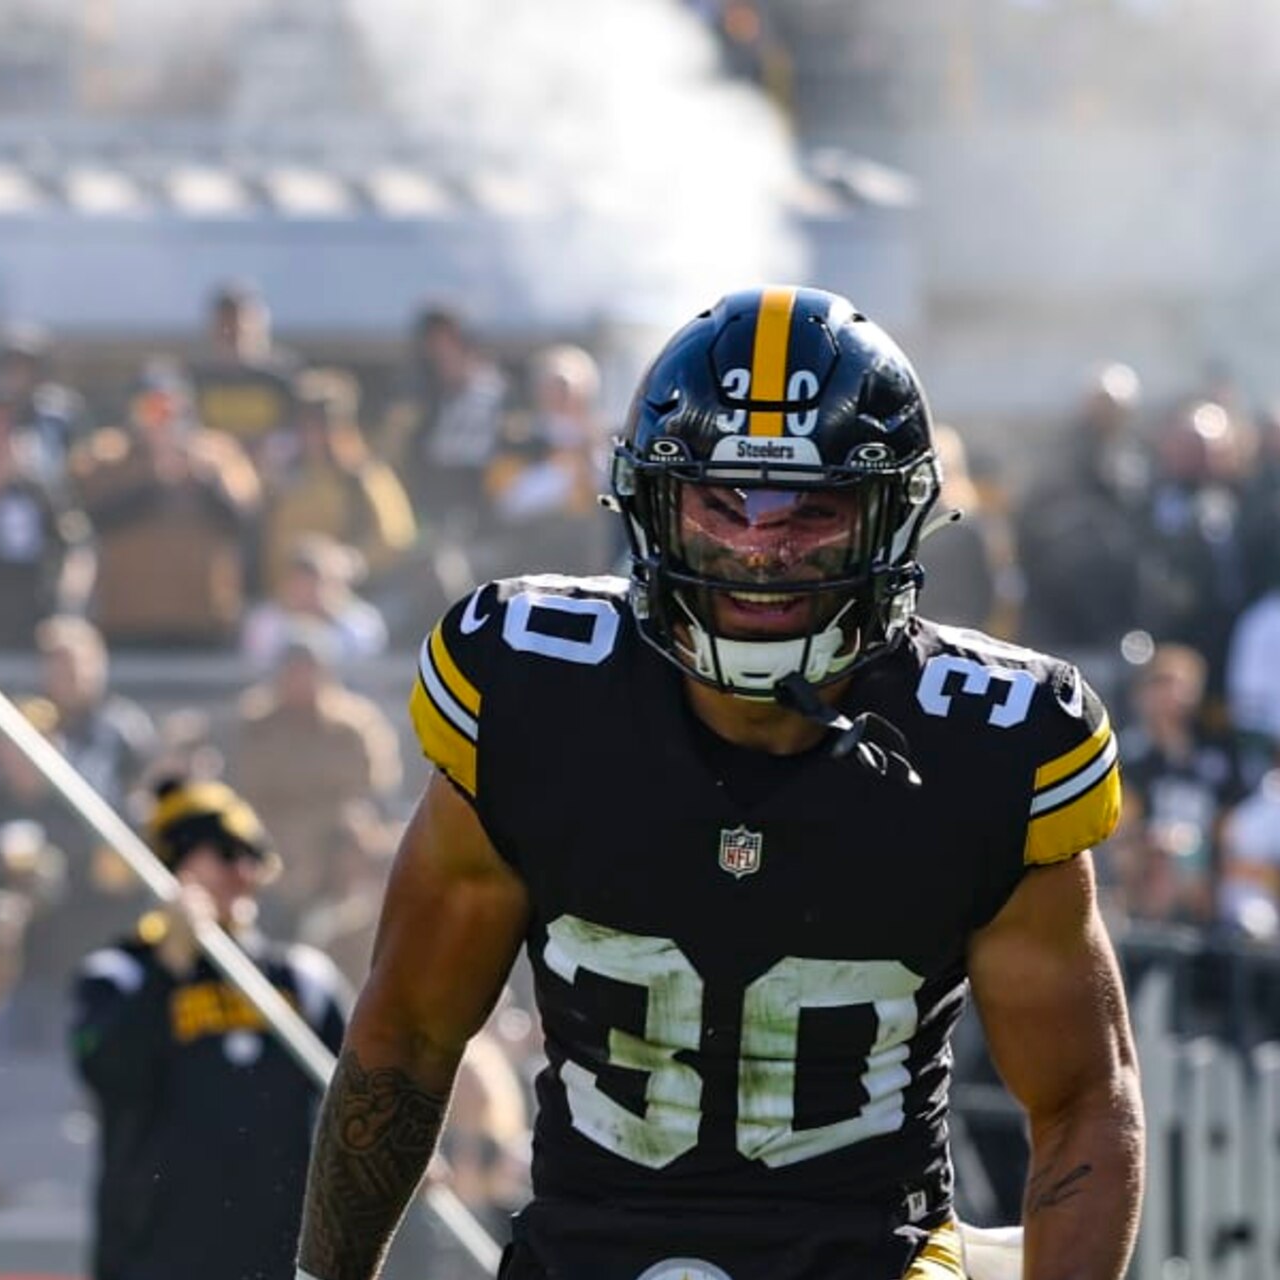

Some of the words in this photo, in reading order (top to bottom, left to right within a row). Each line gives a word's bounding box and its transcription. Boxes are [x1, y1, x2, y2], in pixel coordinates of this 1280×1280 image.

[717, 368, 819, 437] 30
[736, 440, 795, 459] Steelers
[502, 590, 620, 665] 0
[916, 653, 1040, 729] 3
[725, 847, 756, 869] NFL
[543, 914, 925, 1169] 30
